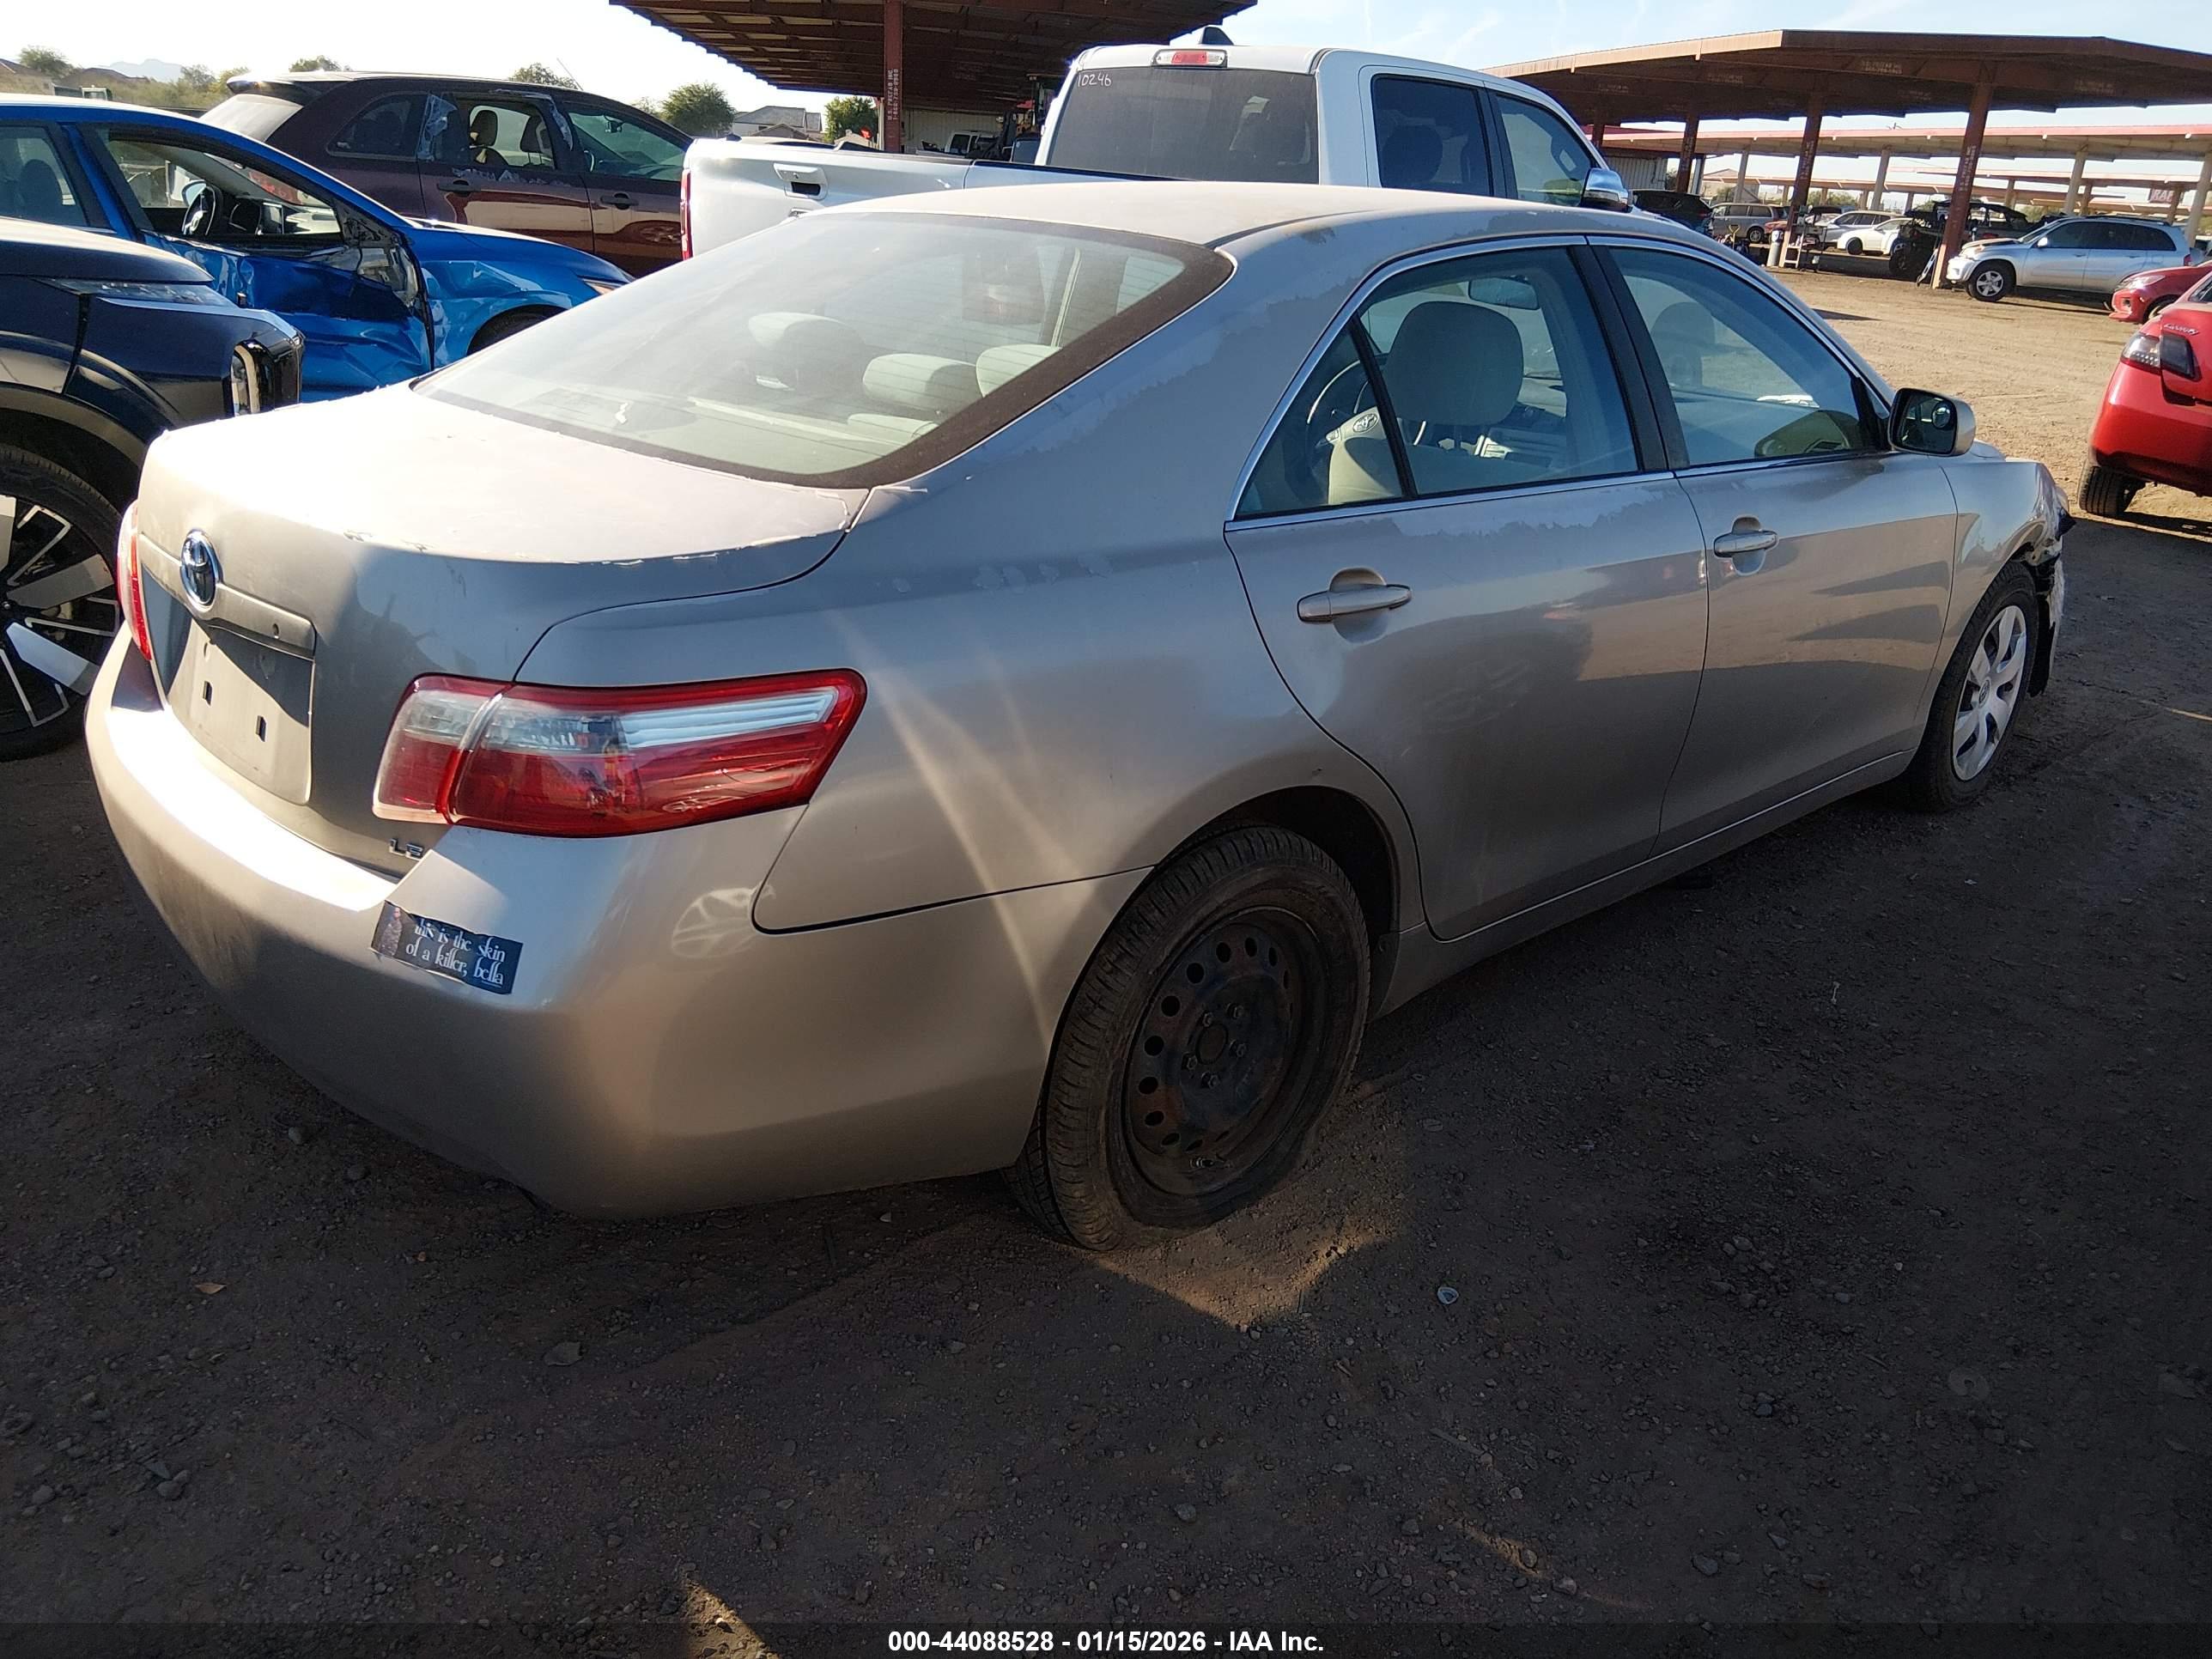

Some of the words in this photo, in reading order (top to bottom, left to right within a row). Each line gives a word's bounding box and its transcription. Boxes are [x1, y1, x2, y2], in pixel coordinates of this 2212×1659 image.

[1078, 72, 1112, 87] 10246
[389, 838, 424, 861] LE
[438, 927, 449, 944] is
[453, 930, 471, 951] the
[477, 937, 506, 963] skin
[405, 936, 422, 957] of
[422, 949, 430, 961] a
[434, 944, 468, 977] killer,
[473, 957, 504, 985] bella
